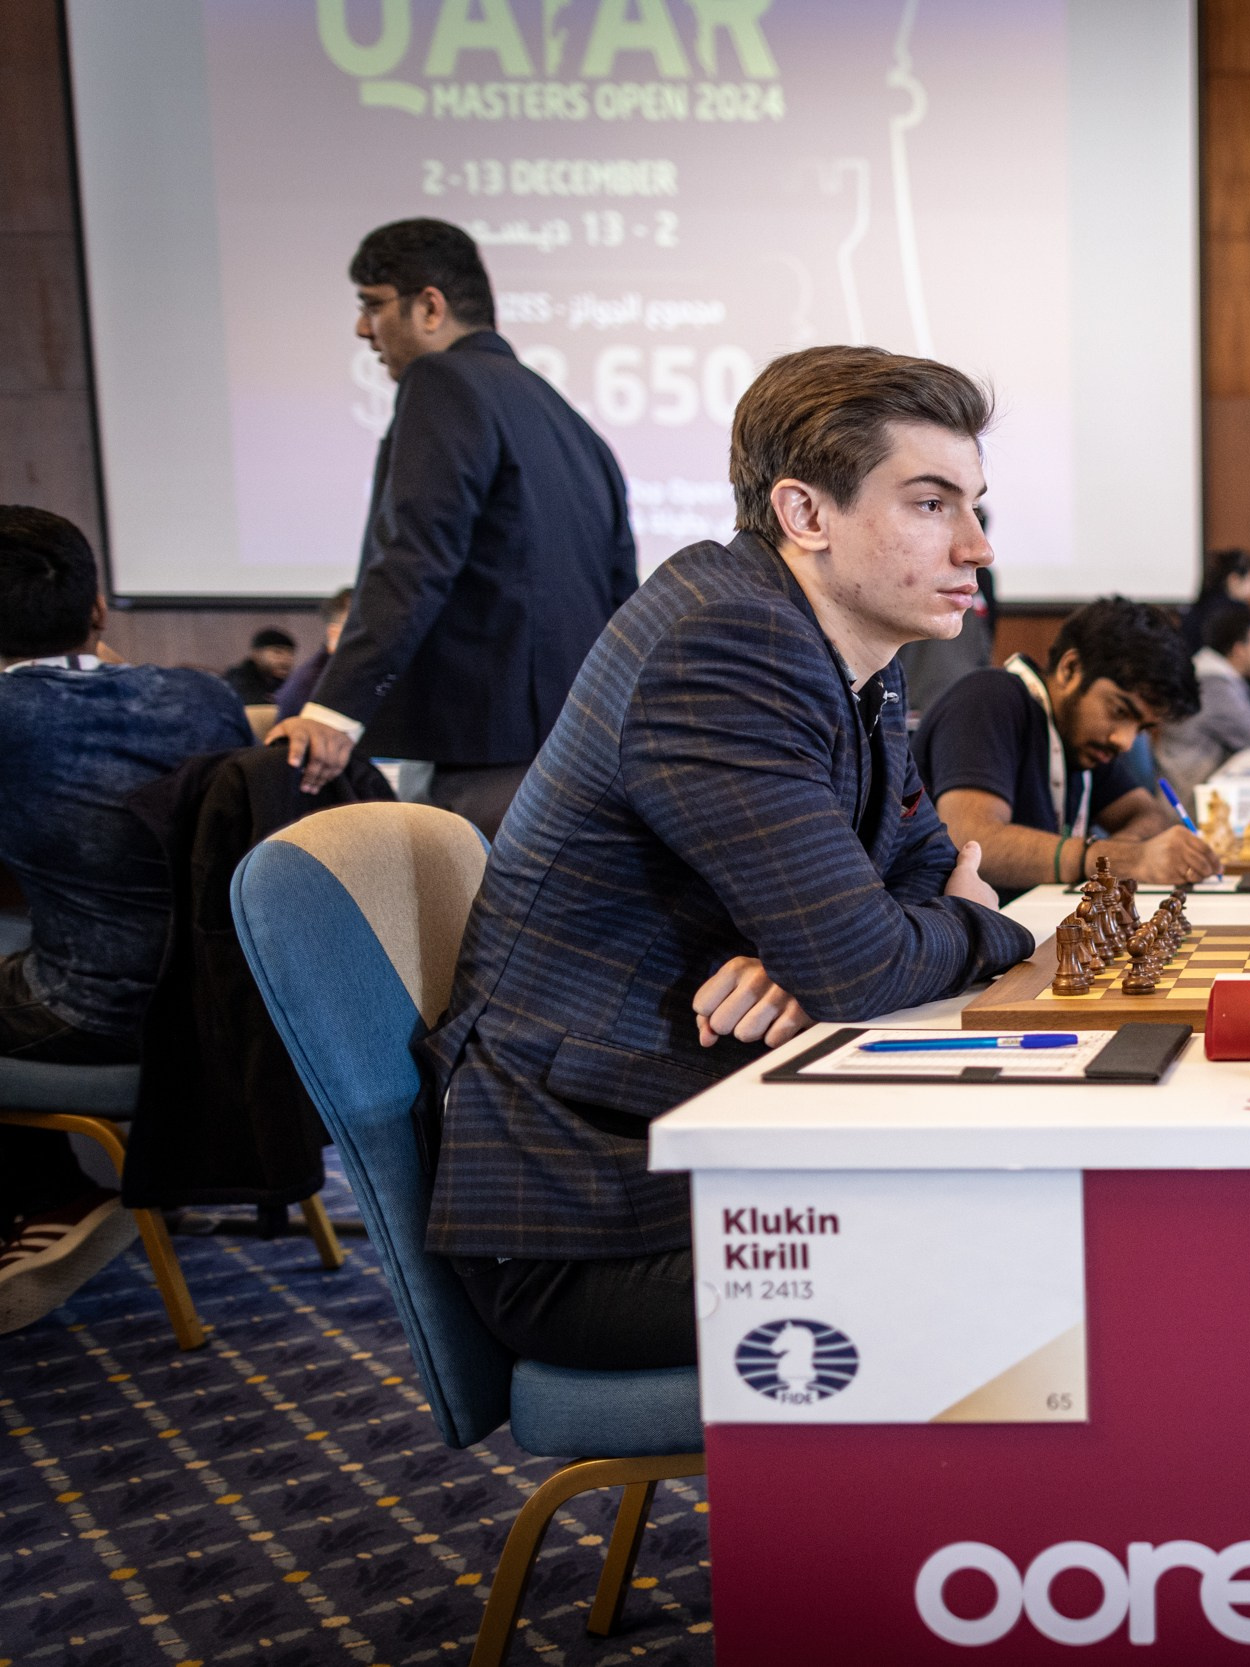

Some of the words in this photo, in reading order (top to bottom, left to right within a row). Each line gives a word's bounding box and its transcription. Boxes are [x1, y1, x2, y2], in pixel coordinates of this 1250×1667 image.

[432, 81, 589, 120] MASTERS
[595, 81, 690, 121] OPEN
[695, 82, 785, 121] 2024
[509, 159, 680, 197] DECEMBER
[724, 1208, 839, 1235] Klukin
[724, 1242, 809, 1270] Kirill
[725, 1281, 753, 1300] IM
[761, 1281, 814, 1300] 2413
[781, 1392, 813, 1405] FIDE
[1046, 1393, 1072, 1410] 65
